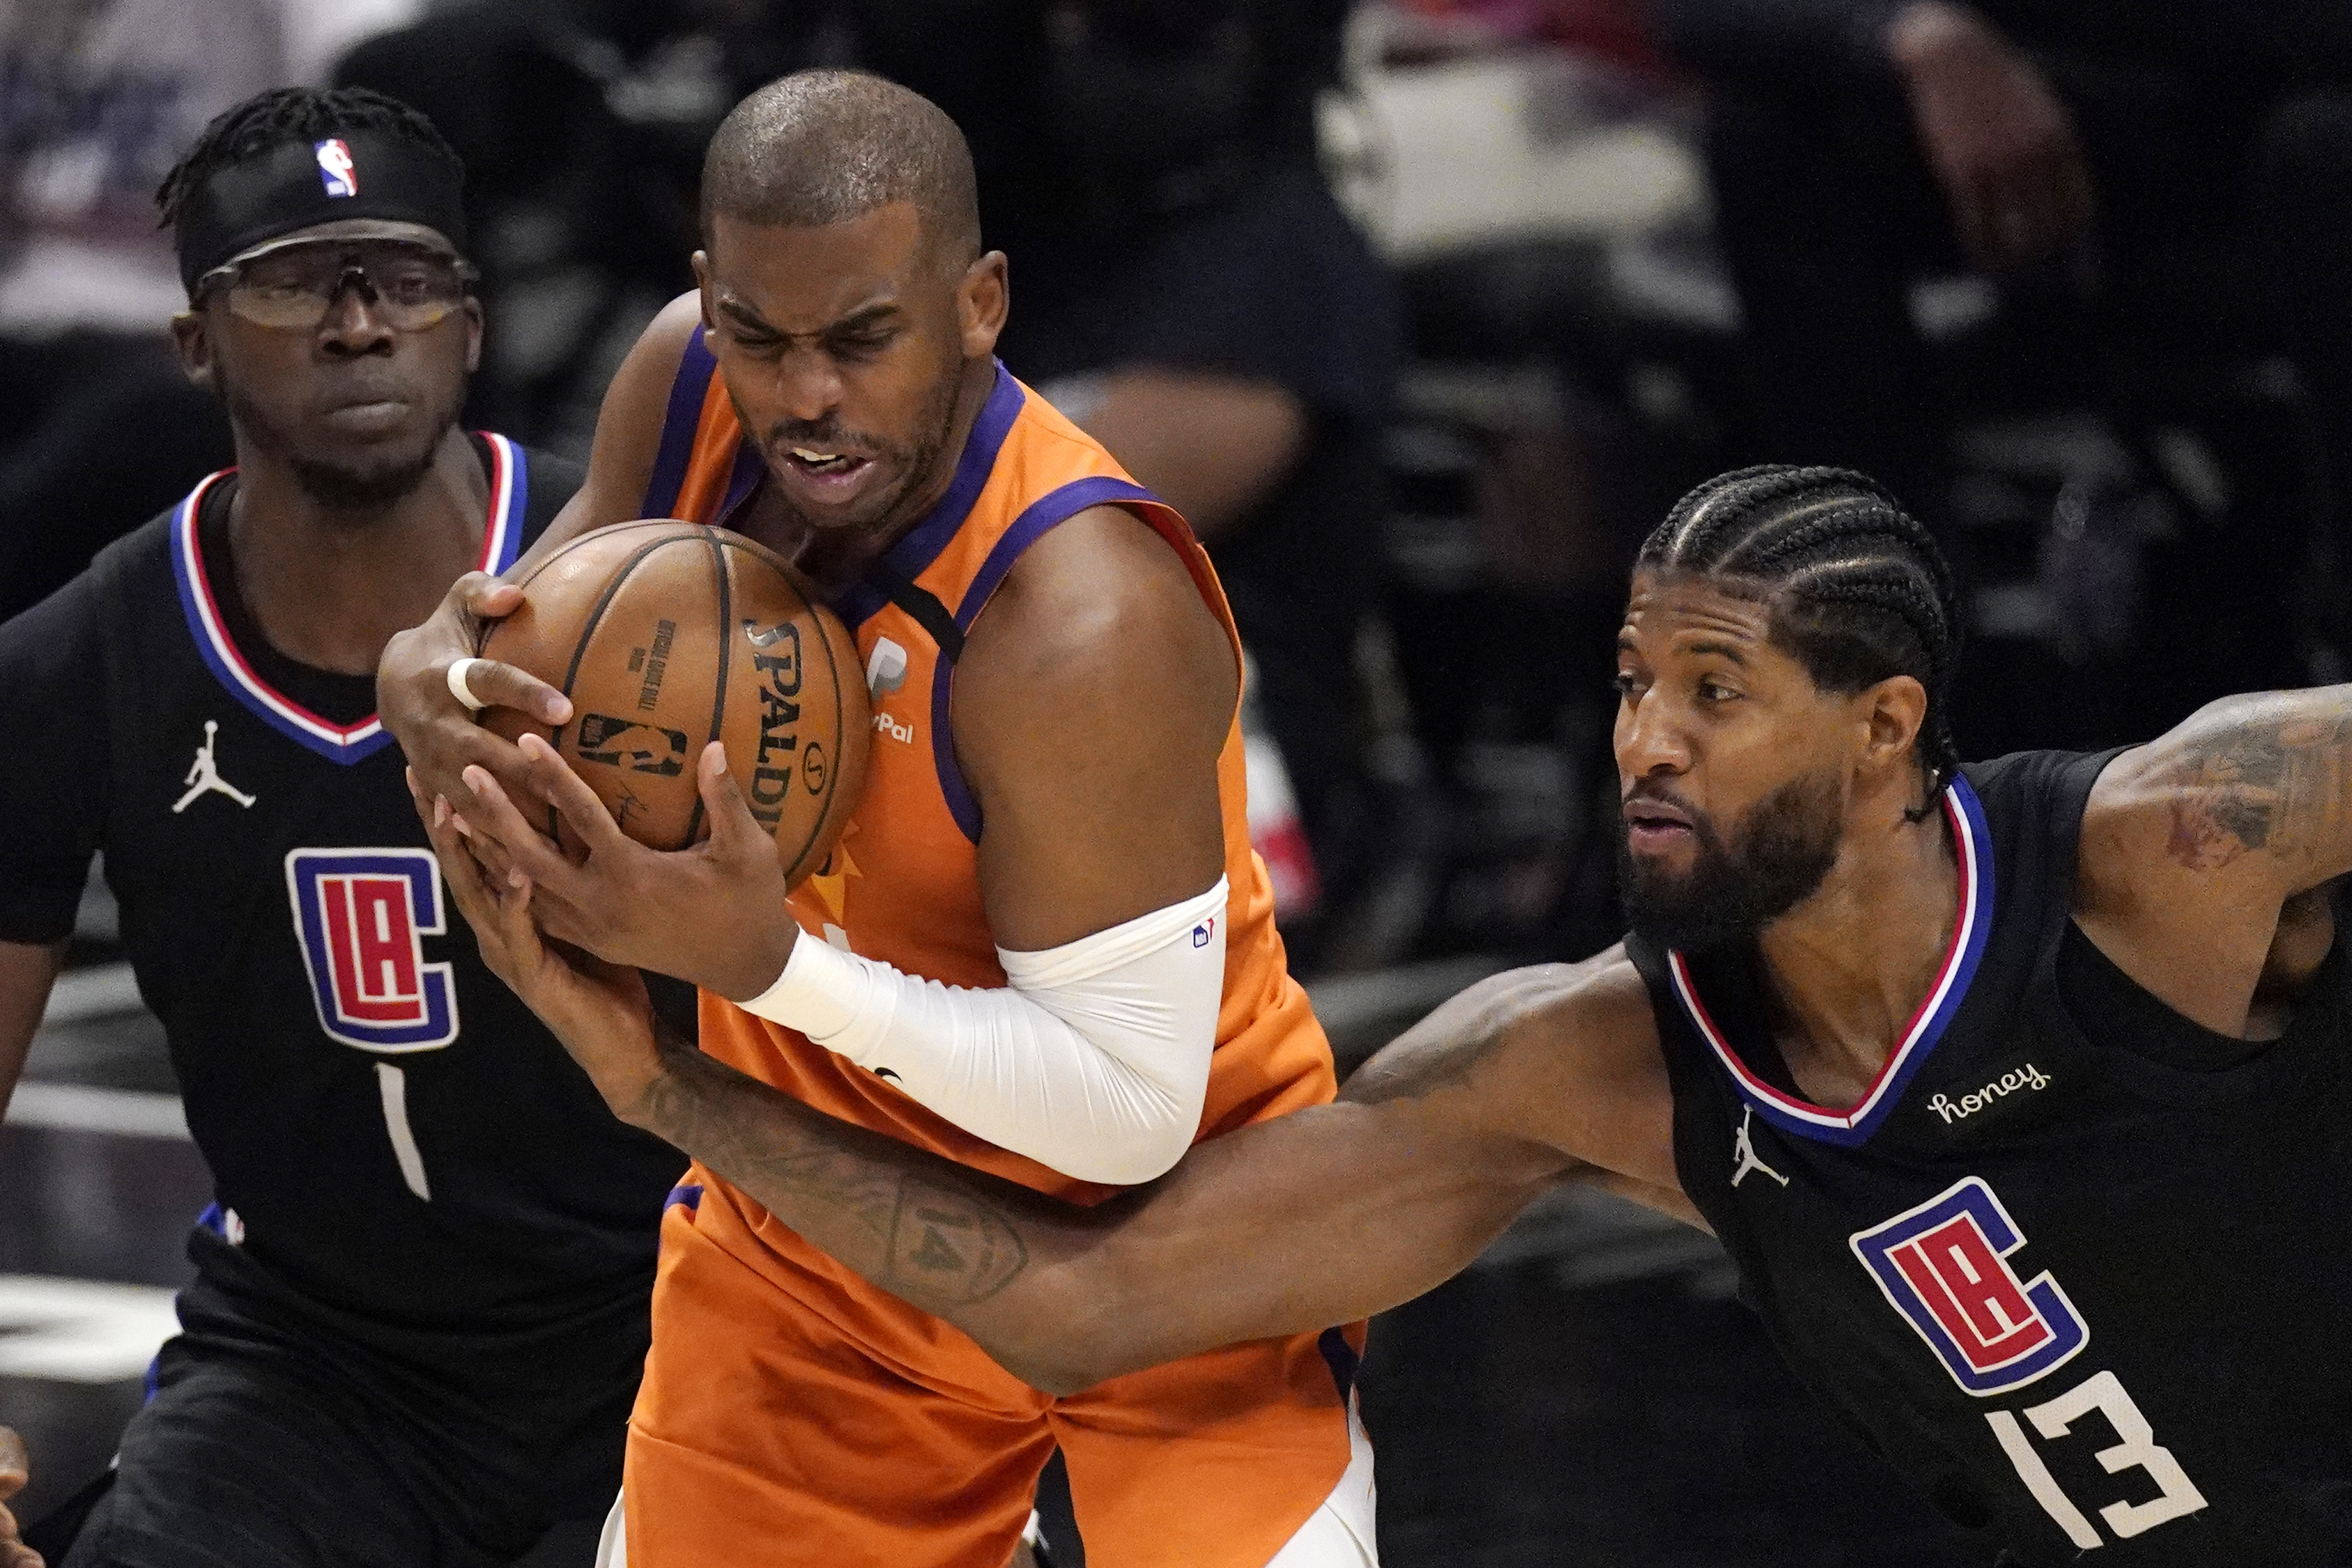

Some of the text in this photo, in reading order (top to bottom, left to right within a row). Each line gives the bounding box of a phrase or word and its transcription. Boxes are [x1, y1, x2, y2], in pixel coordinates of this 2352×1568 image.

[743, 619, 801, 836] SPALDI
[873, 712, 913, 744] Pal
[374, 1062, 430, 1202] 1
[1928, 1063, 2051, 1124] honey
[1985, 1370, 2208, 1549] 13
